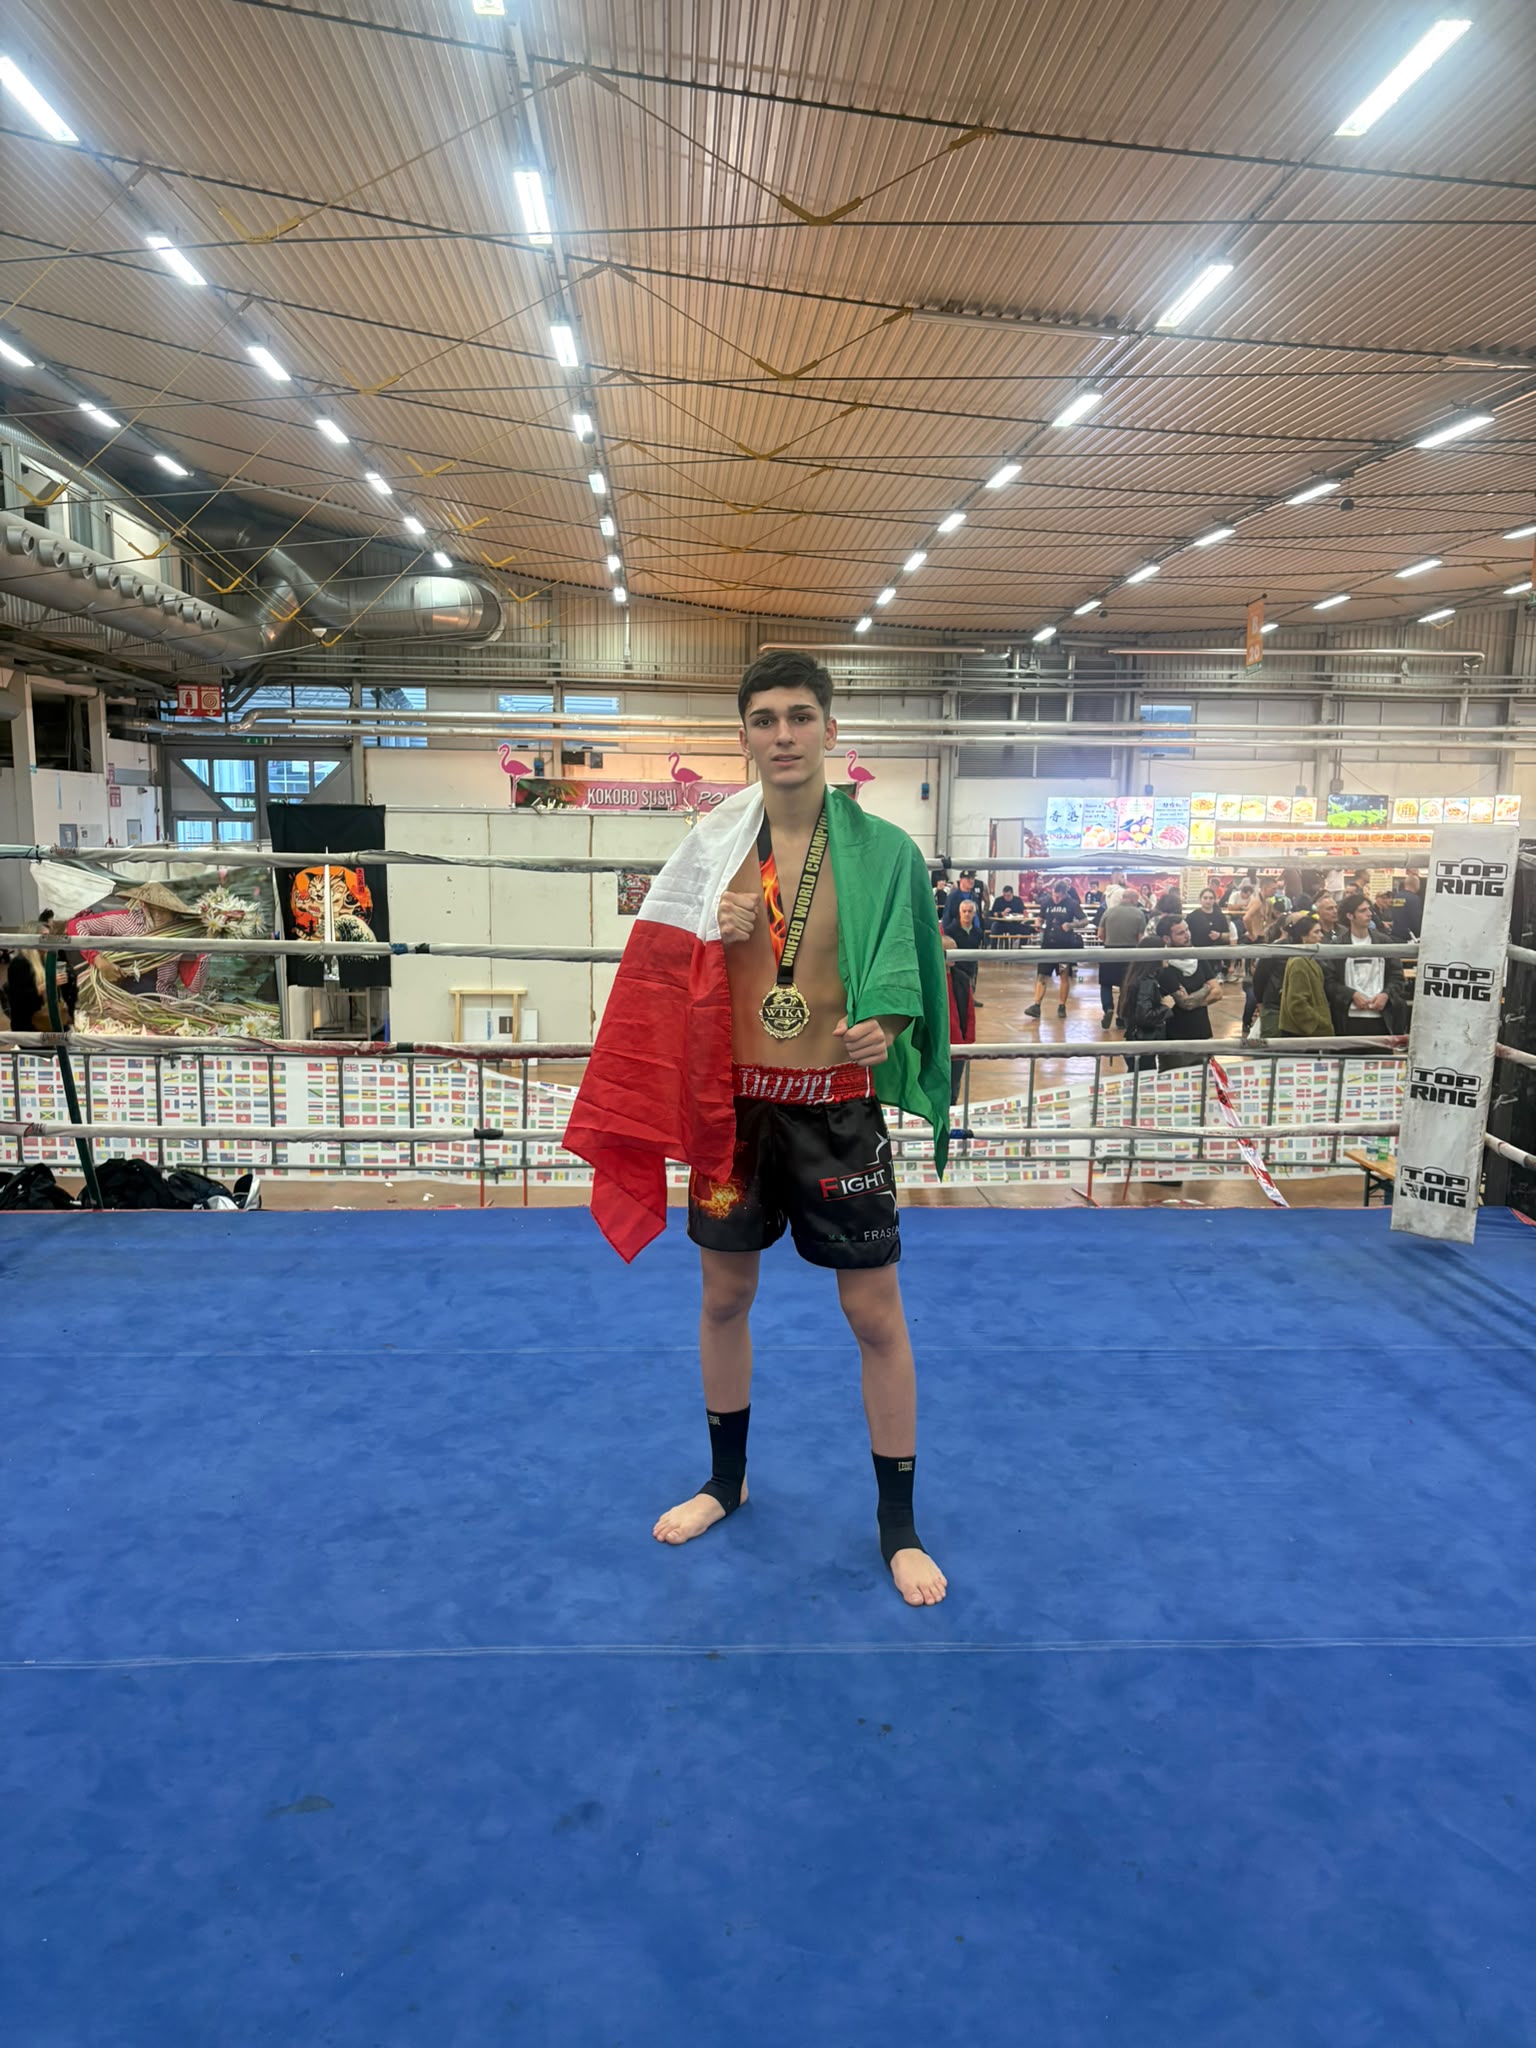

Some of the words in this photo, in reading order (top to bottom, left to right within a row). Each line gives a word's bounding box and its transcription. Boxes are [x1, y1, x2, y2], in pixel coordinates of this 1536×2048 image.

[588, 789, 638, 805] KOKORO
[642, 789, 677, 805] SUSHI
[698, 791, 729, 805] PO
[1439, 863, 1504, 877] TOP
[1435, 878, 1504, 897] RING
[781, 920, 805, 967] UNIFIED
[793, 874, 817, 918] WORLD
[1427, 966, 1491, 982] TOP
[1423, 981, 1491, 1002] RING
[1414, 1070, 1477, 1088] TOP
[1410, 1084, 1478, 1108] RING
[819, 1169, 886, 1199] FIGHT
[1404, 1168, 1466, 1187] TOP
